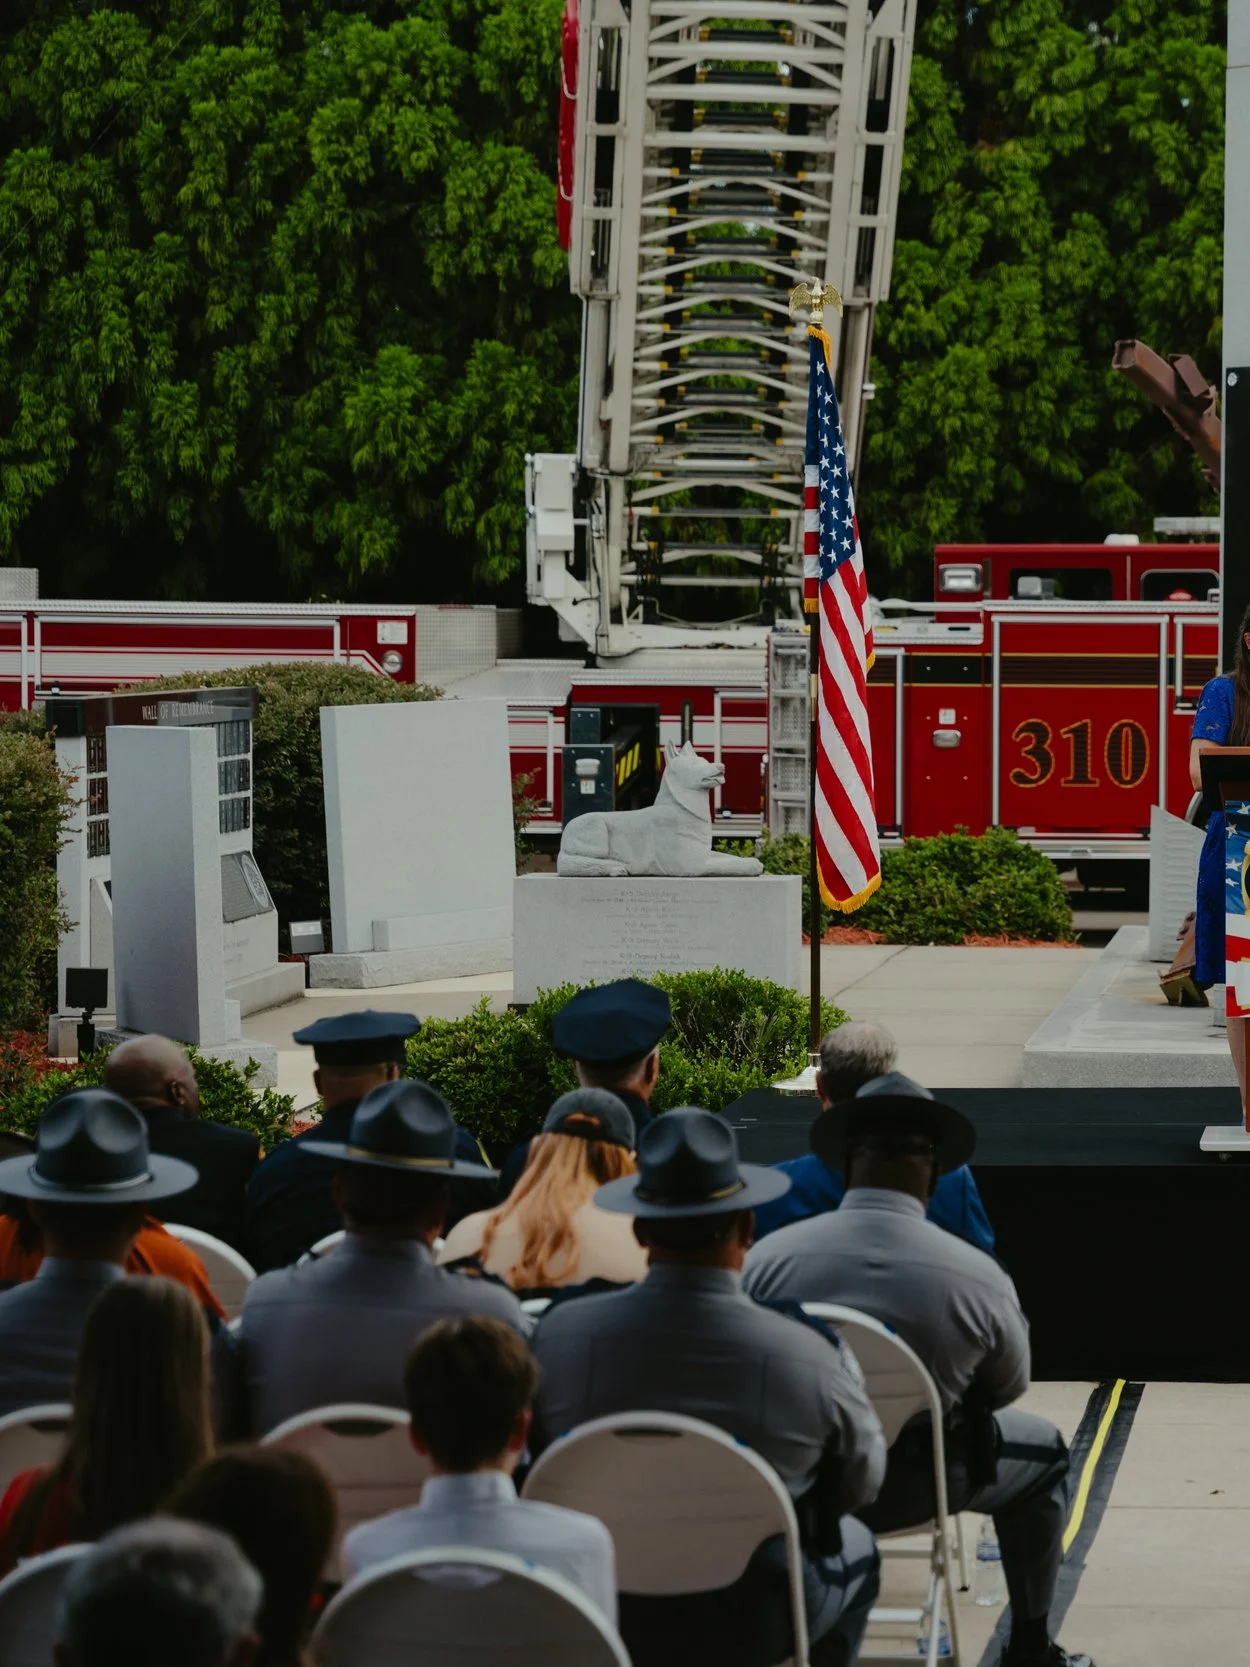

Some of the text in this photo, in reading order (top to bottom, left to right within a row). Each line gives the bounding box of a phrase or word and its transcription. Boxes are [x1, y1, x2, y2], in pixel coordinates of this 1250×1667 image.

[142, 700, 215, 720] WALL OF REMEMBRANCE
[1009, 718, 1151, 789] 310
